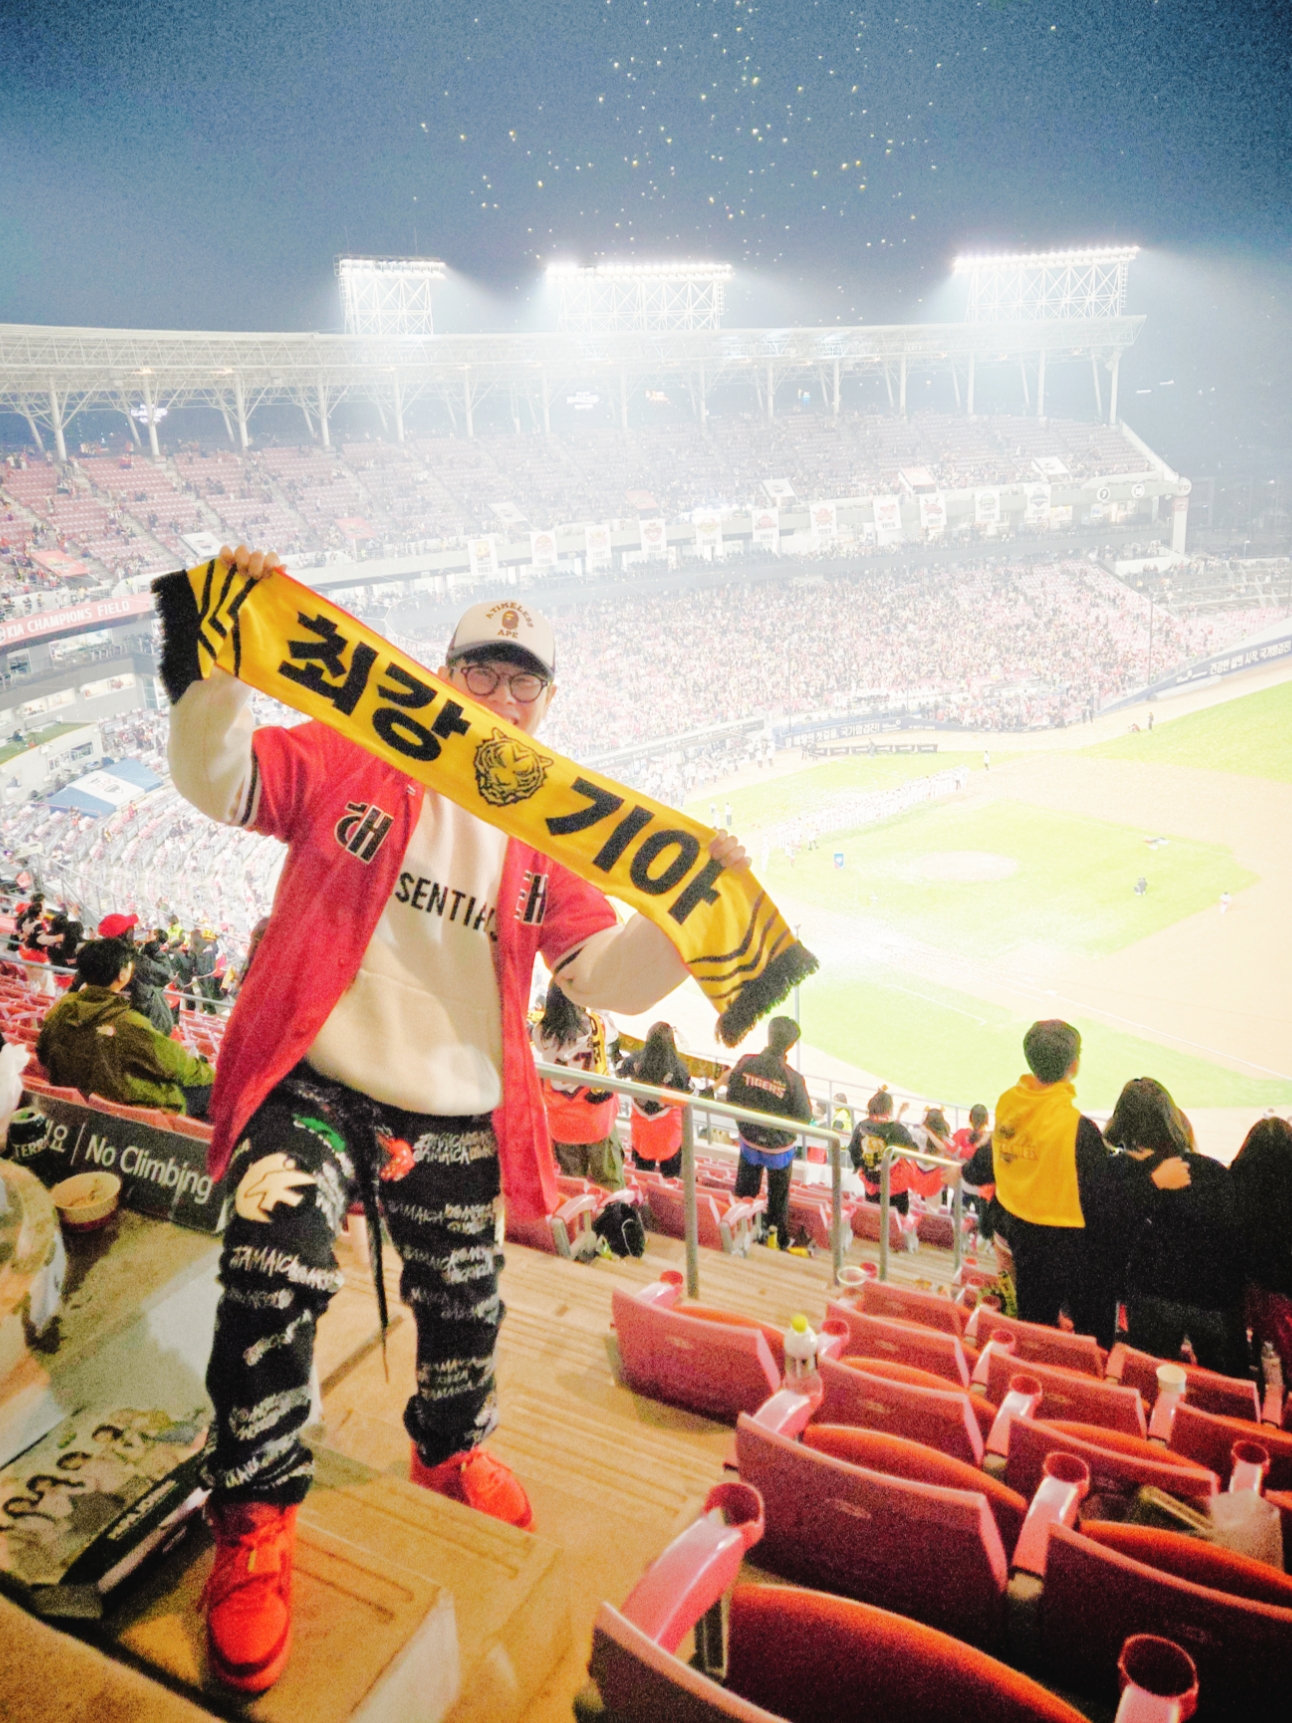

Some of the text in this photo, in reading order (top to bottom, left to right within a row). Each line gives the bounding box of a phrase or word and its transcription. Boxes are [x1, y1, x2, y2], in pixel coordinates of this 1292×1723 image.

[7, 600, 130, 639] KIA CHAMPIONS FIELD
[497, 629, 518, 639] APE
[279, 611, 727, 926] 최강 기아
[742, 1072, 786, 1099] TIGERS
[84, 1134, 214, 1205] No Climbing
